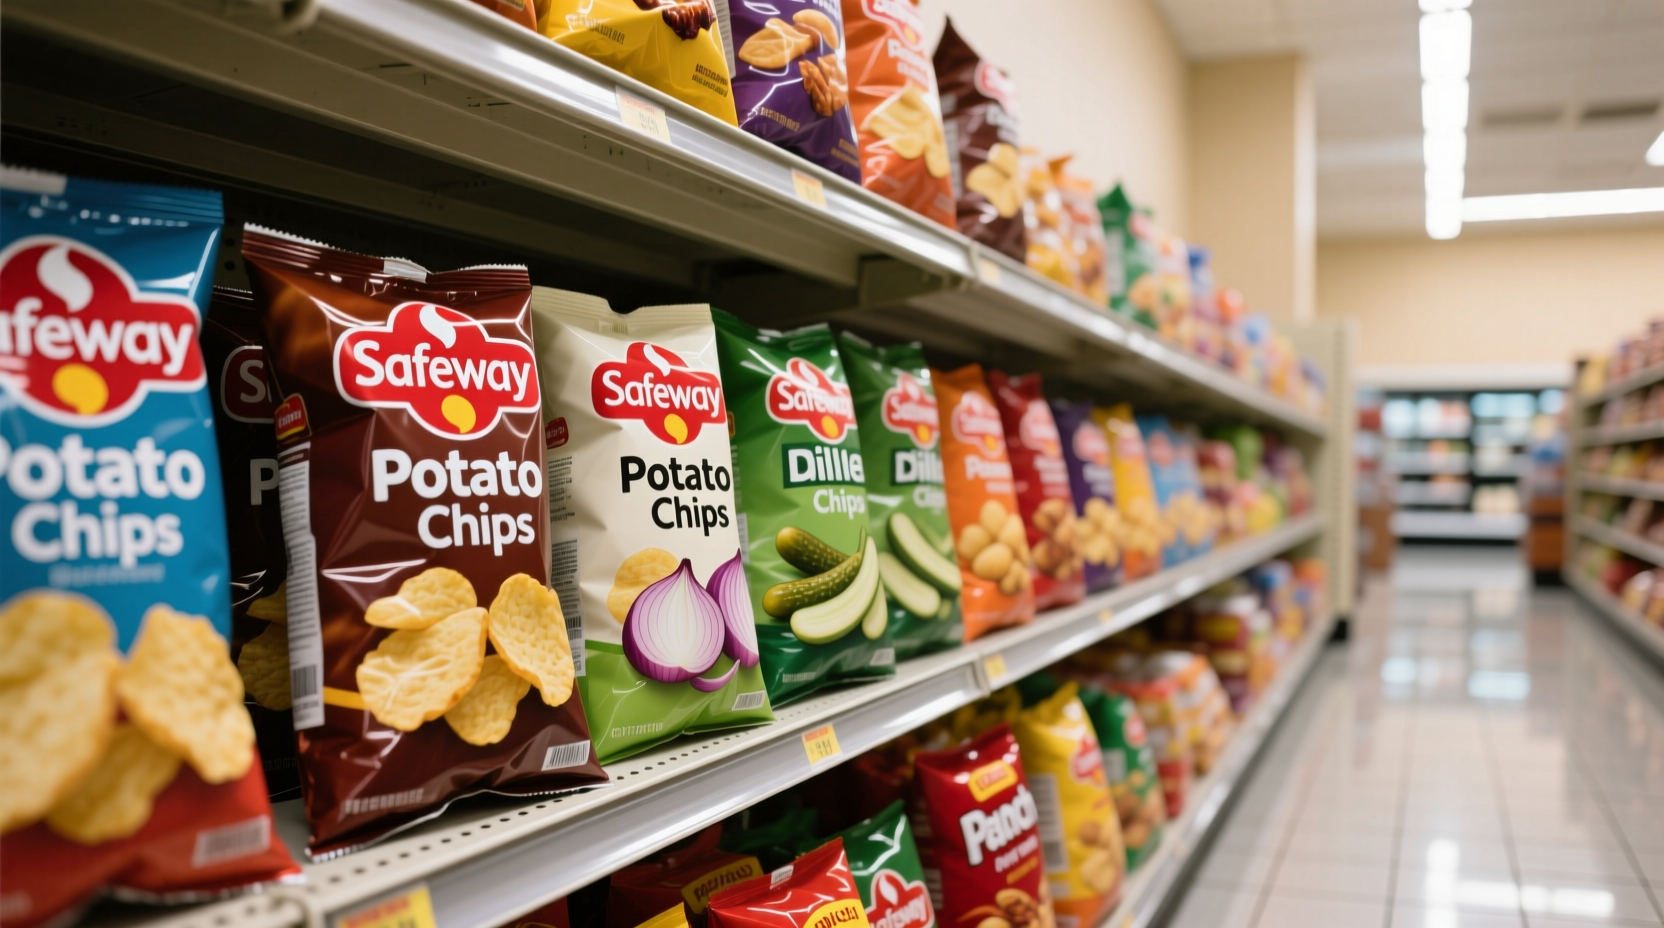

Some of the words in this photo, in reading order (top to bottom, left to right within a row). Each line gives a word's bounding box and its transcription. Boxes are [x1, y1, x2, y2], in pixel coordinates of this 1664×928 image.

[353, 340, 531, 402] Safeway
[602, 370, 721, 418] Safeway
[0, 433, 205, 500] otato
[371, 448, 543, 503] Potato
[620, 456, 731, 493] Potato
[11, 500, 183, 568] Chips
[417, 502, 535, 556] Chips
[651, 496, 730, 536] Chips
